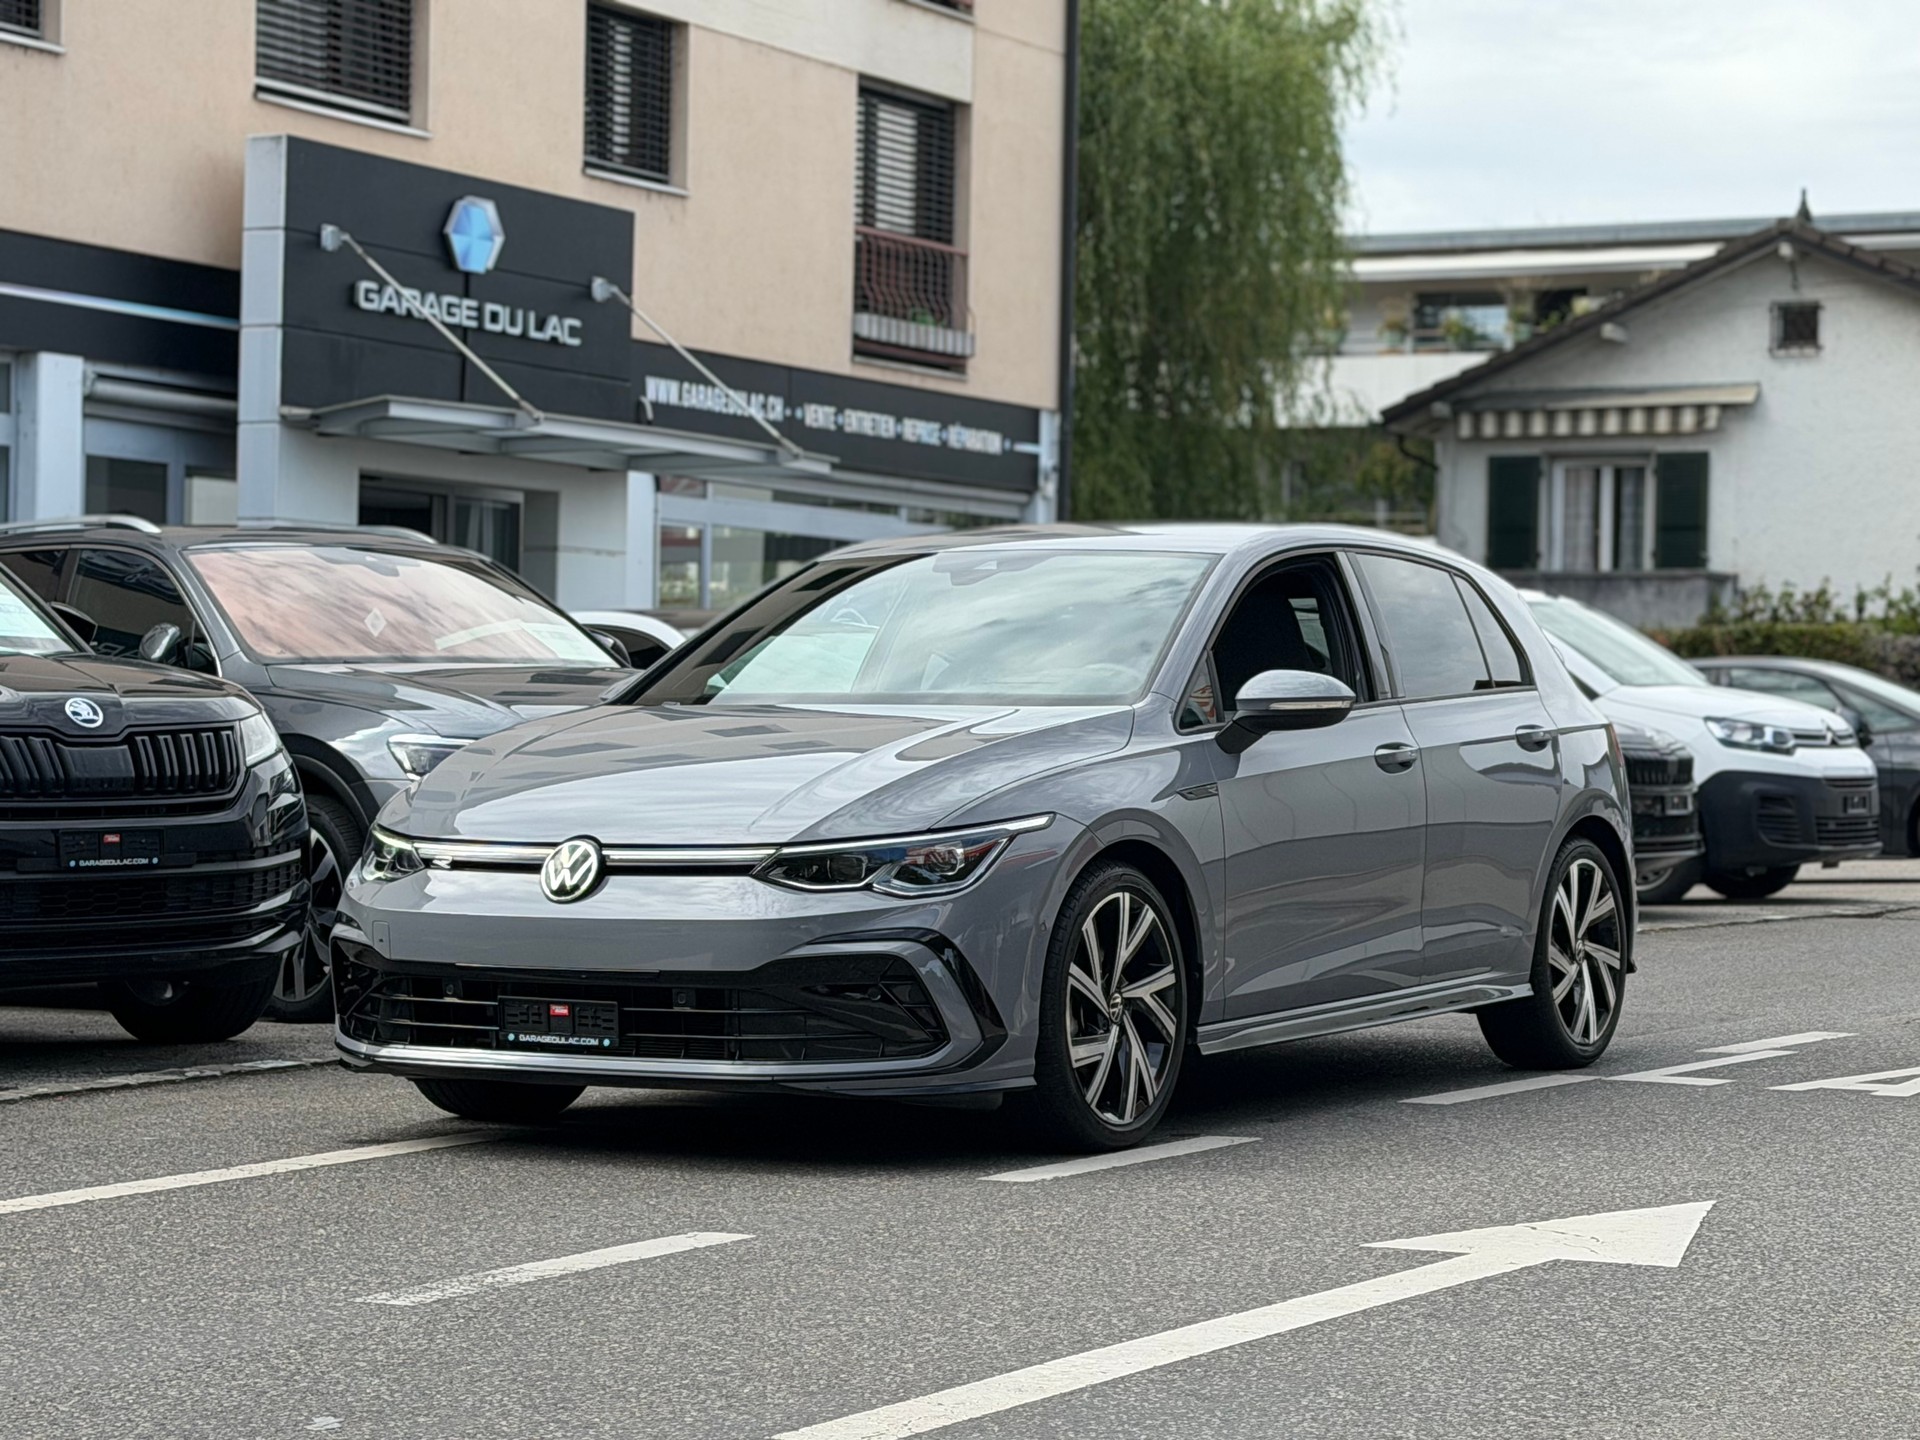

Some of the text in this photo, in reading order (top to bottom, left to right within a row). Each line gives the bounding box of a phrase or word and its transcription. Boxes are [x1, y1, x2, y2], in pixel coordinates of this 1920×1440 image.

[356, 279, 583, 347] GARAGE DU LAC
[518, 1033, 600, 1046] GARAGEDULAC.COM
